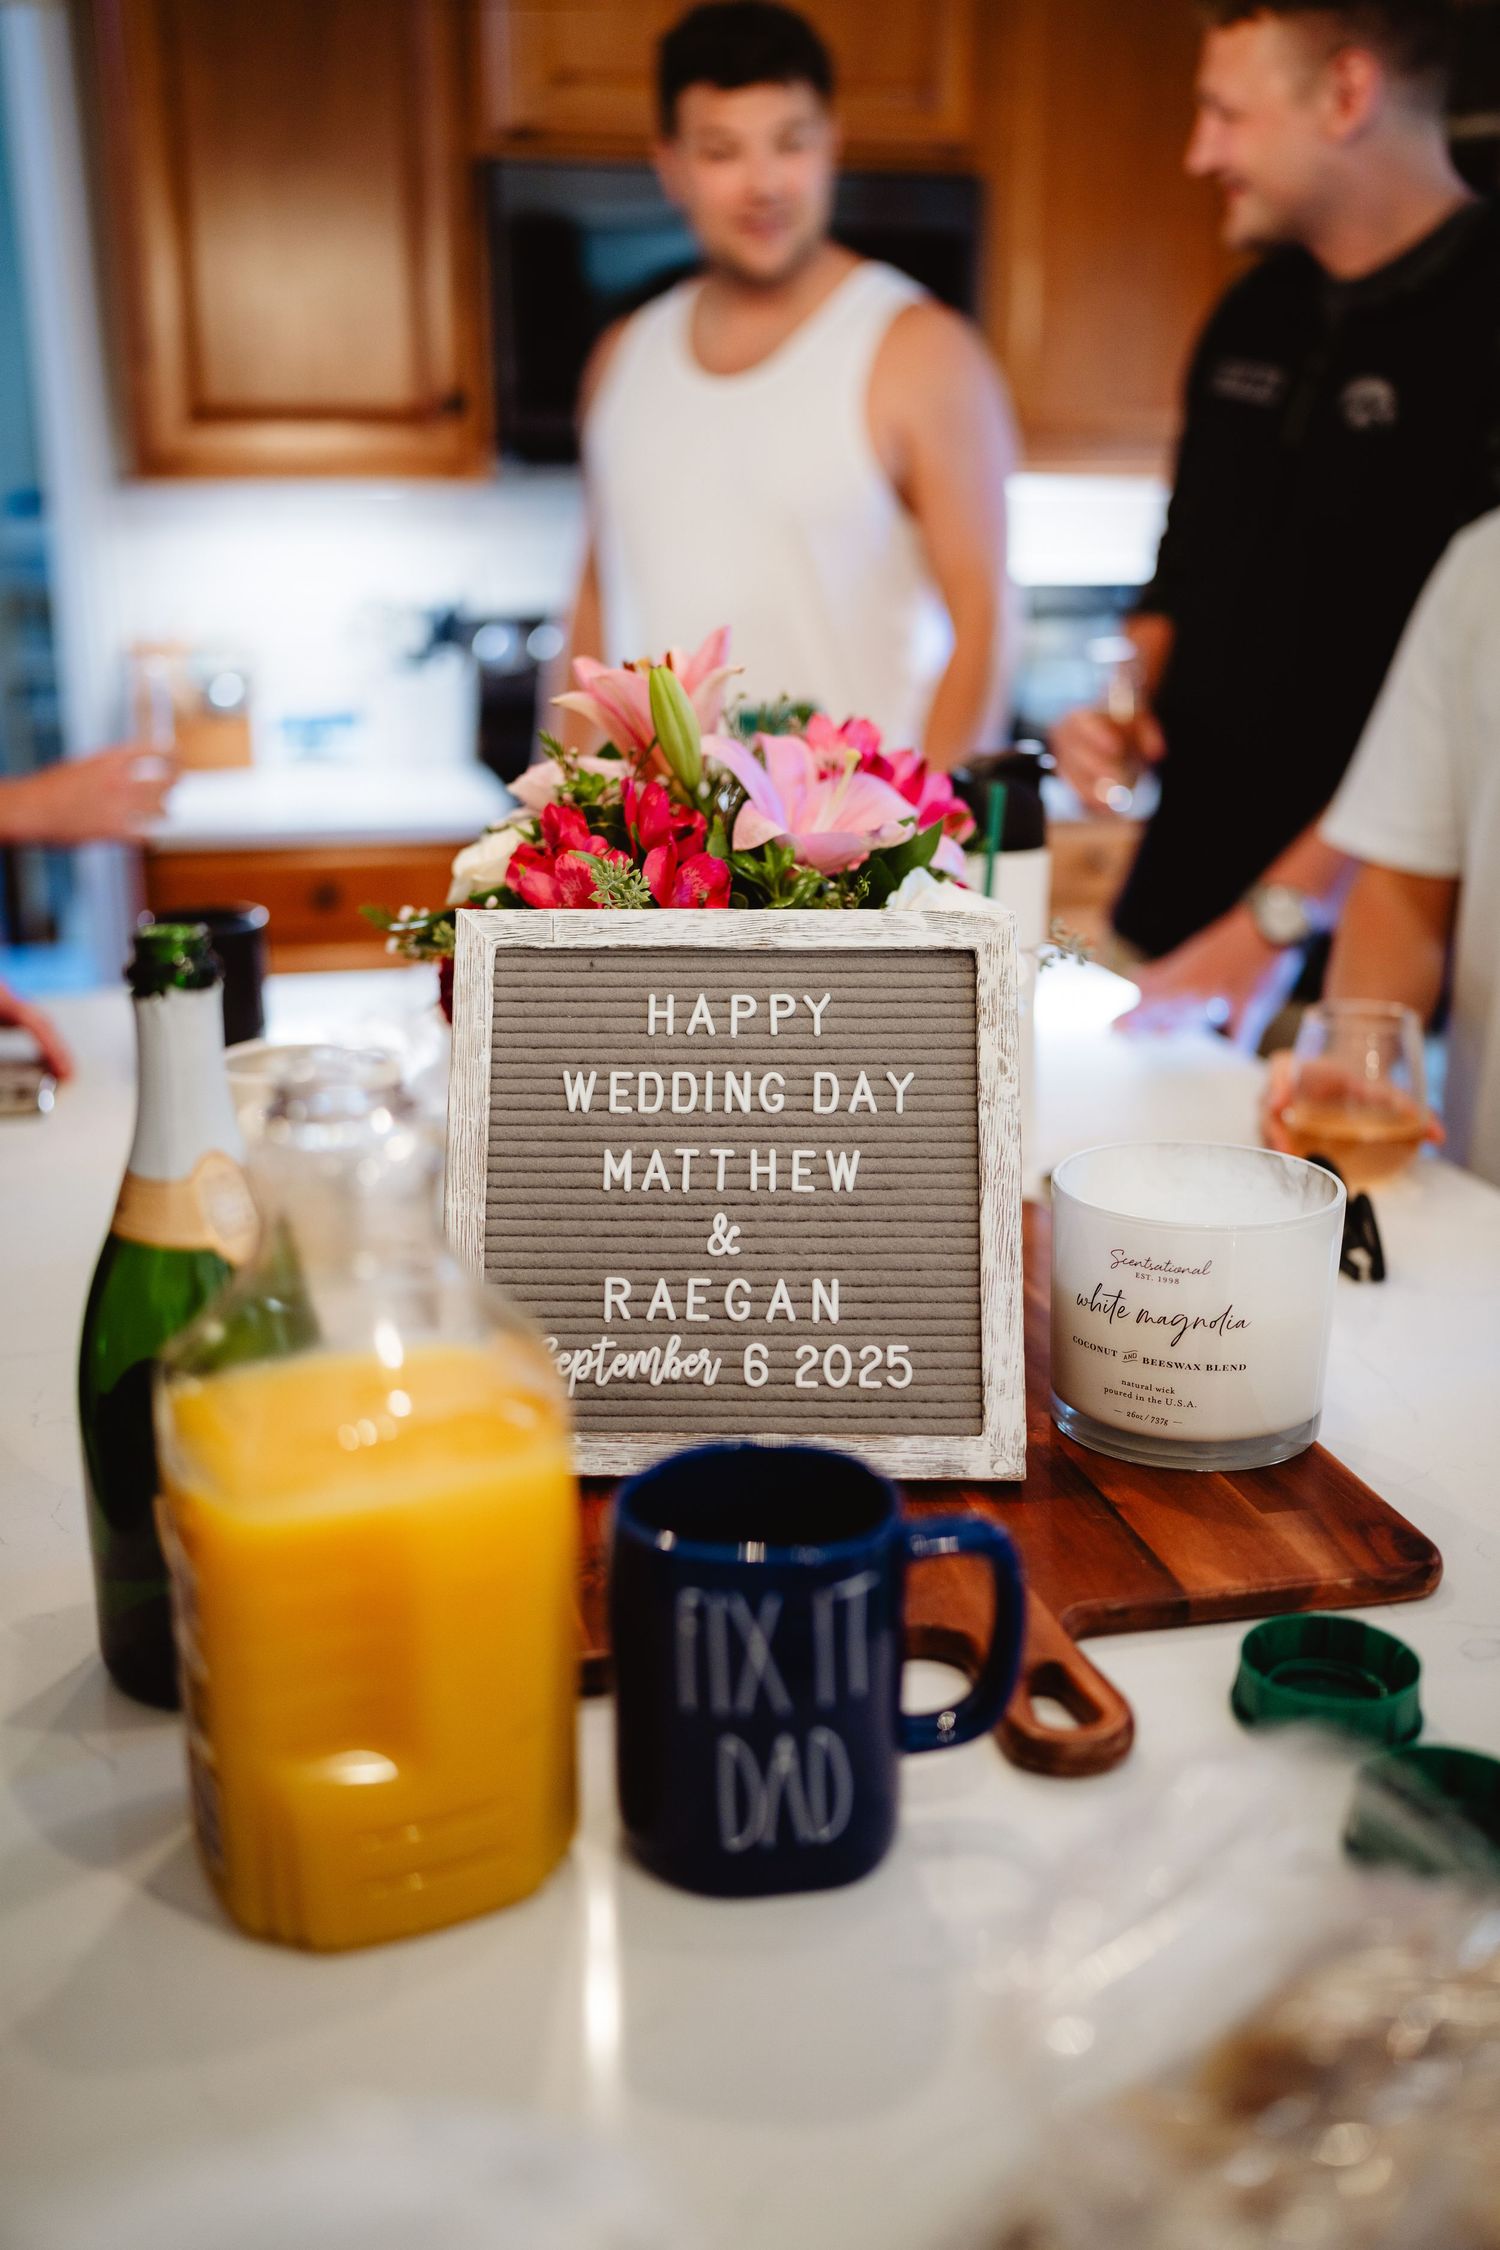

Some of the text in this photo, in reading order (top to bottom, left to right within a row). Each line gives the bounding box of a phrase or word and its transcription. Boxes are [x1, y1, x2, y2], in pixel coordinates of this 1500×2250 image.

[647, 993, 831, 1038] HAPPY
[563, 1070, 915, 1115] WEDDING DAY
[603, 1148, 860, 1193] MATTHEW
[706, 1213, 741, 1256] &
[1110, 1249, 1212, 1276] Scentsational
[1135, 1272, 1180, 1285] EST. 1998
[604, 1277, 840, 1324] RAEGAN
[1077, 1283, 1251, 1347] white magnolia
[743, 1343, 769, 1386] 6
[795, 1343, 913, 1389] 2025
[1072, 1335, 1247, 1372] COCONUT AND BEESWAX BLEND
[1104, 1386, 1198, 1408] poured in the U.S.A.
[1121, 1379, 1176, 1395] natural wick
[813, 1570, 880, 1710] IT
[716, 1725, 854, 1853] DAD
